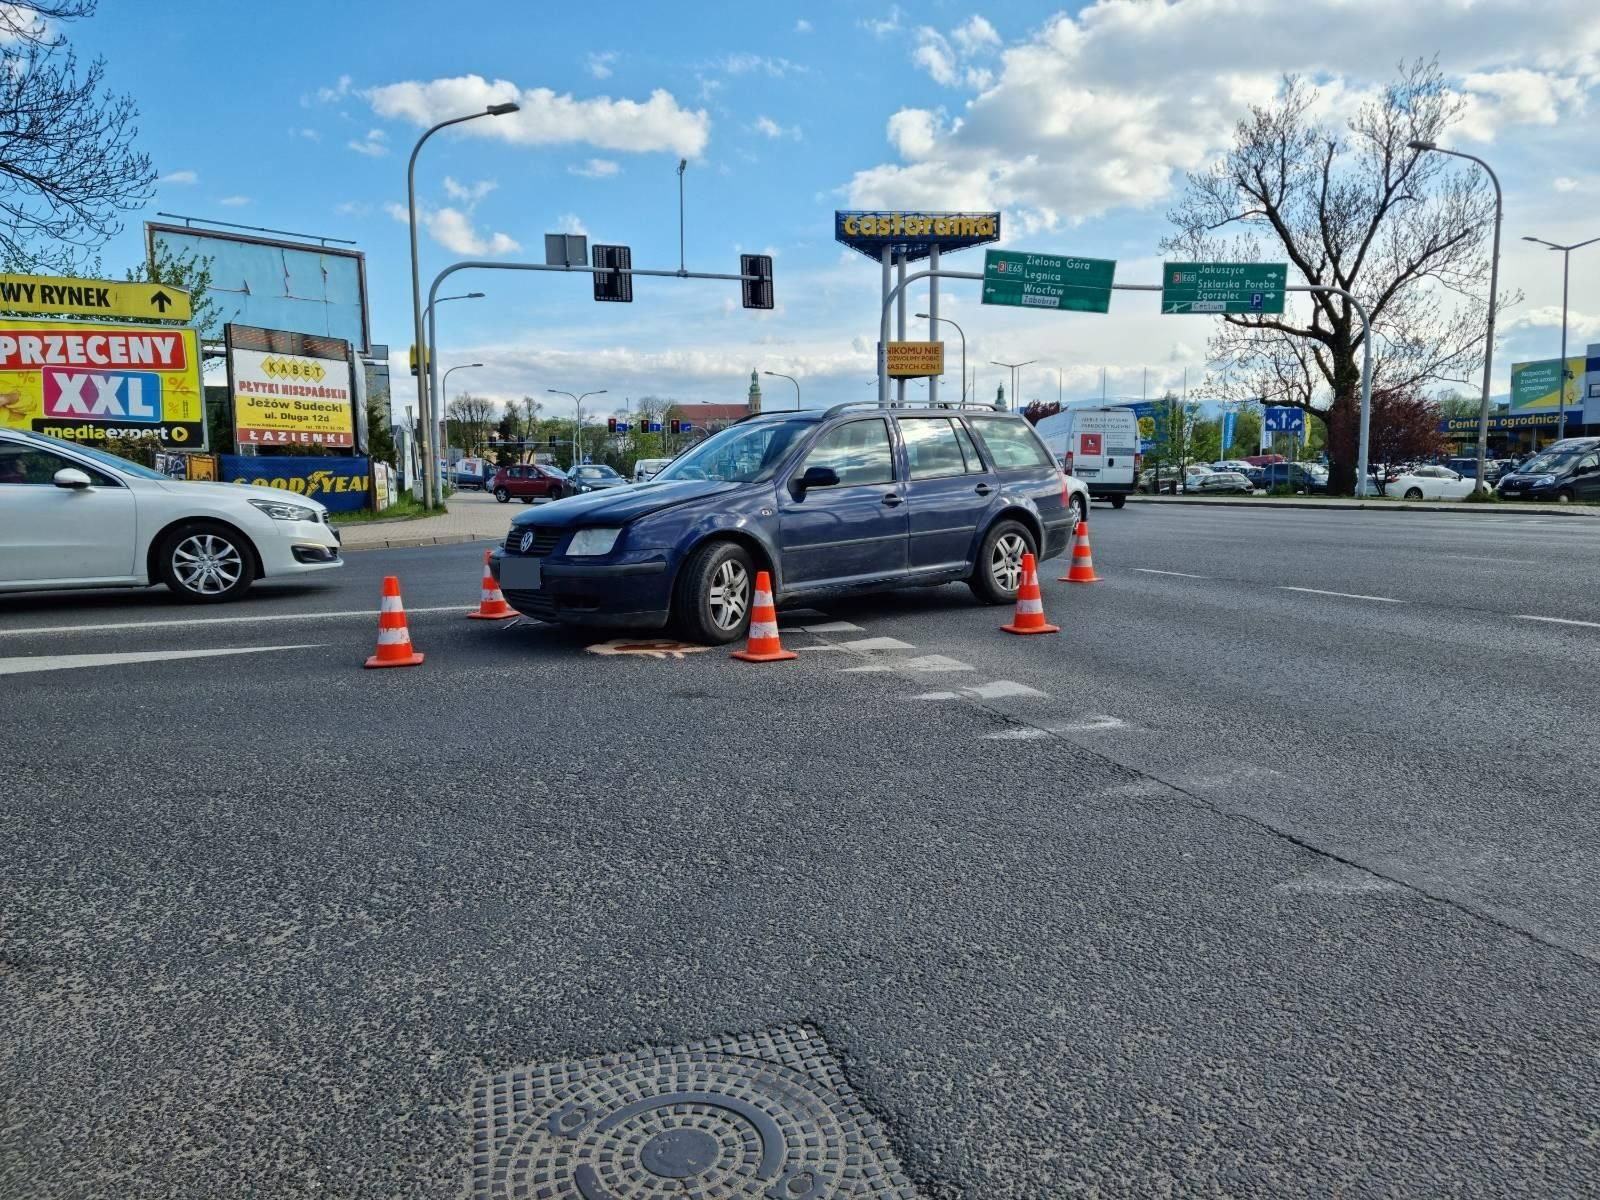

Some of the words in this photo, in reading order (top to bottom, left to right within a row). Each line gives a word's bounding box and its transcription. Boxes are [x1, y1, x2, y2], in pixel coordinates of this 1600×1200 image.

[844, 215, 994, 236] castorama
[1008, 264, 1022, 272] E65
[1026, 256, 1061, 268] Zielona
[1066, 259, 1090, 270] Góra
[1025, 269, 1061, 281] Legnica
[1199, 265, 1245, 276] Jakuszyce
[1024, 283, 1064, 295] Wrocław
[1198, 279, 1240, 289] Szklarska
[40, 284, 112, 307] RYNEK
[1024, 296, 1057, 306] Zabobrze
[1197, 291, 1240, 301] Zgorzelec
[0, 335, 176, 365] PRZECENY
[924, 346, 940, 355] NIE
[268, 362, 321, 377] KABET
[239, 380, 279, 394] PŁYTKI
[52, 372, 155, 417] XXL
[247, 398, 290, 409] Jeżów
[294, 401, 343, 413] Sudecki
[264, 412, 278, 420] ul.
[280, 413, 309, 423] Długa
[312, 415, 330, 423] 12d
[1448, 419, 1497, 429] Centrm
[248, 430, 345, 444] ŁAZIENKI
